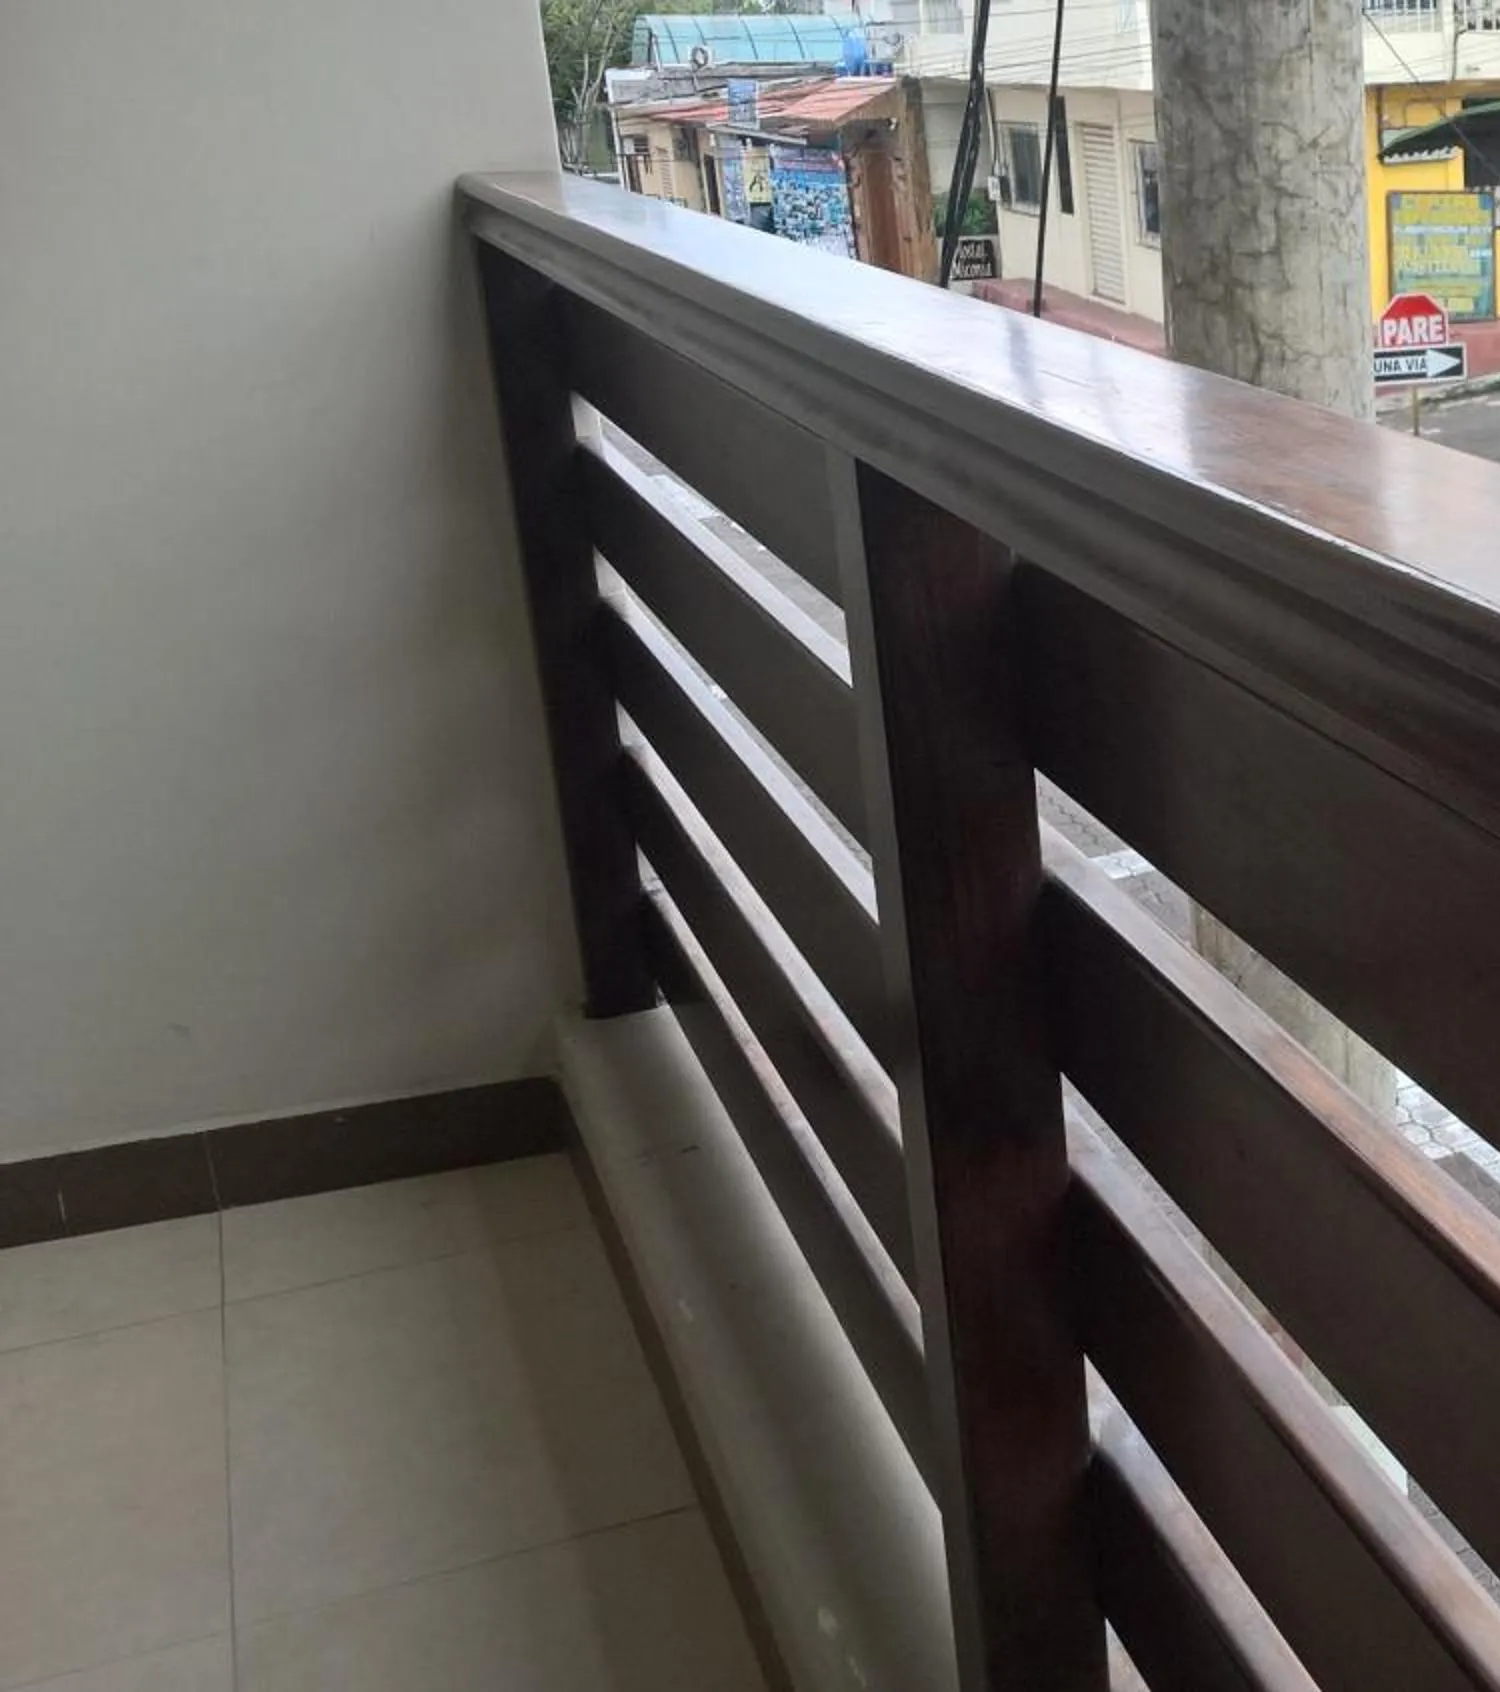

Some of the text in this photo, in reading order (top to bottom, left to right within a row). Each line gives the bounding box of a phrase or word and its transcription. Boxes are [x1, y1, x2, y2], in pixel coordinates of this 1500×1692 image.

[1382, 313, 1445, 346] PARE
[1373, 356, 1428, 373] UNA VIA
